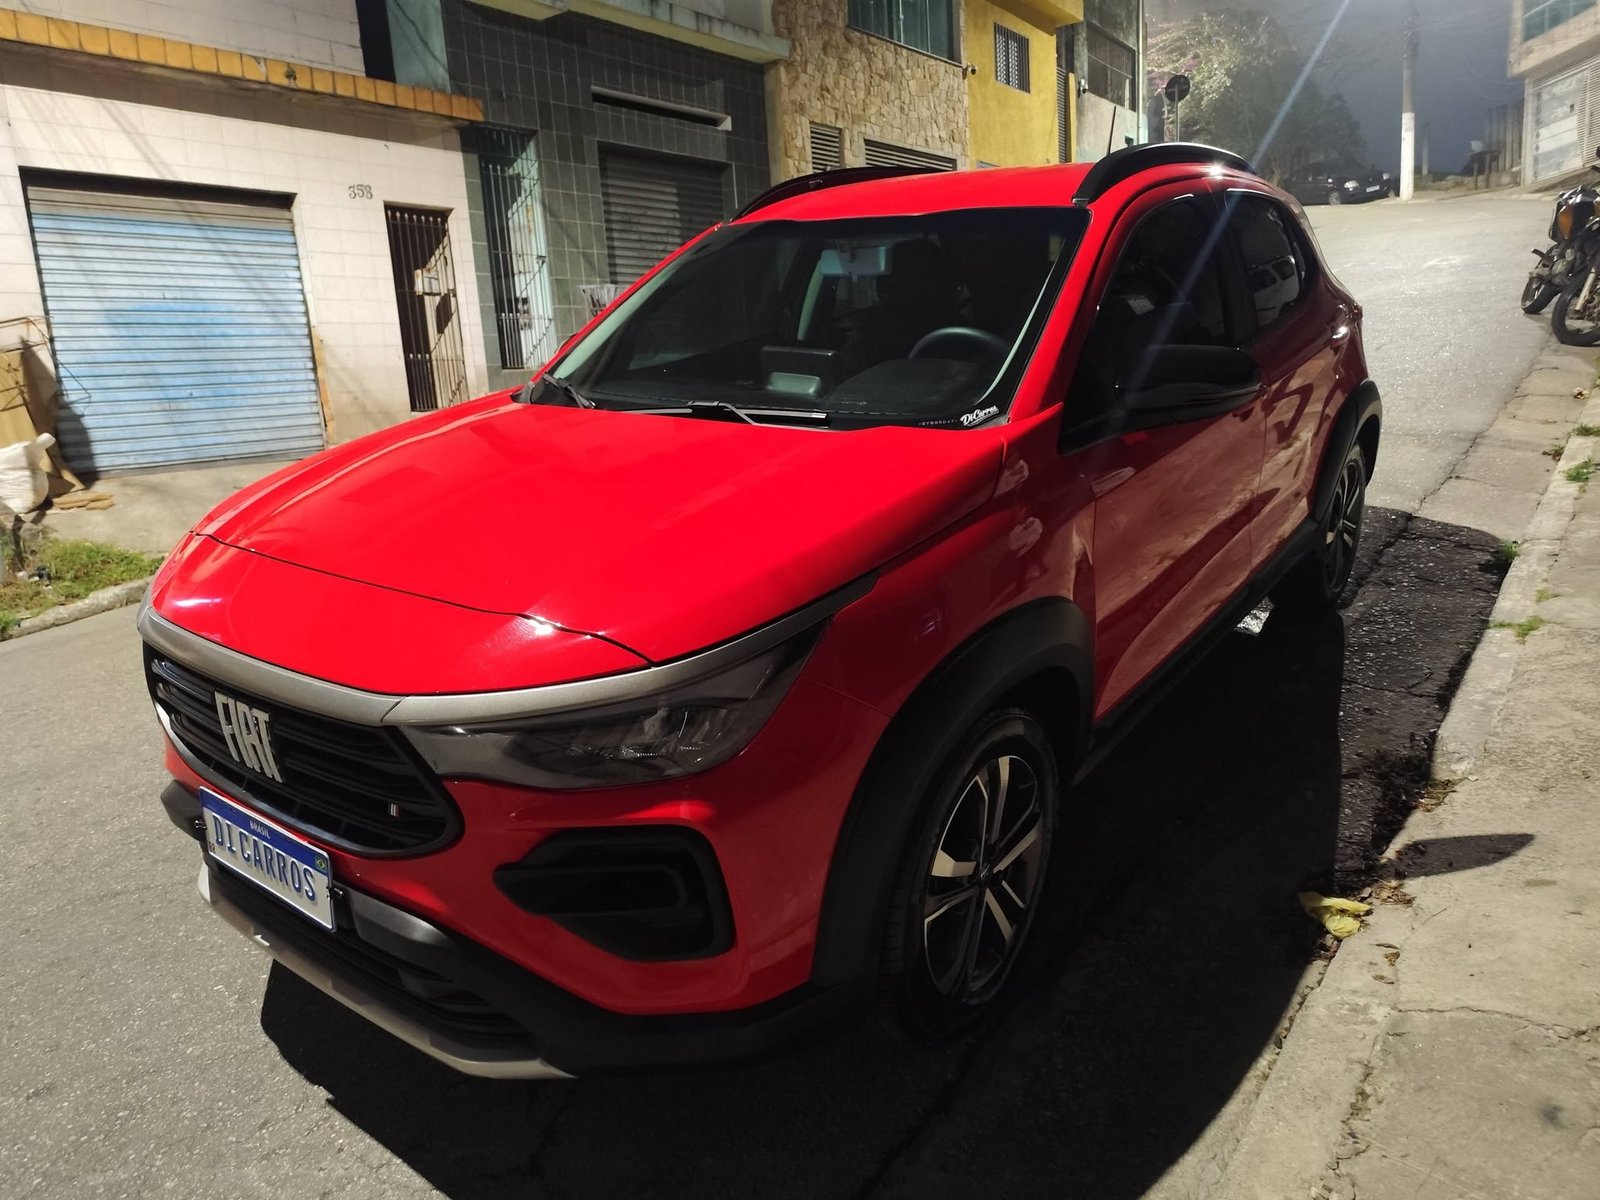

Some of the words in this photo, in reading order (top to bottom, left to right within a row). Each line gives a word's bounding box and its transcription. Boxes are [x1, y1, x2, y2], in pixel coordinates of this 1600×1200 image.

[348, 184, 373, 200] 358
[214, 691, 283, 783] FIAT
[249, 820, 271, 839] BRASIL
[212, 813, 236, 854] DI
[239, 829, 316, 902] CARROS
